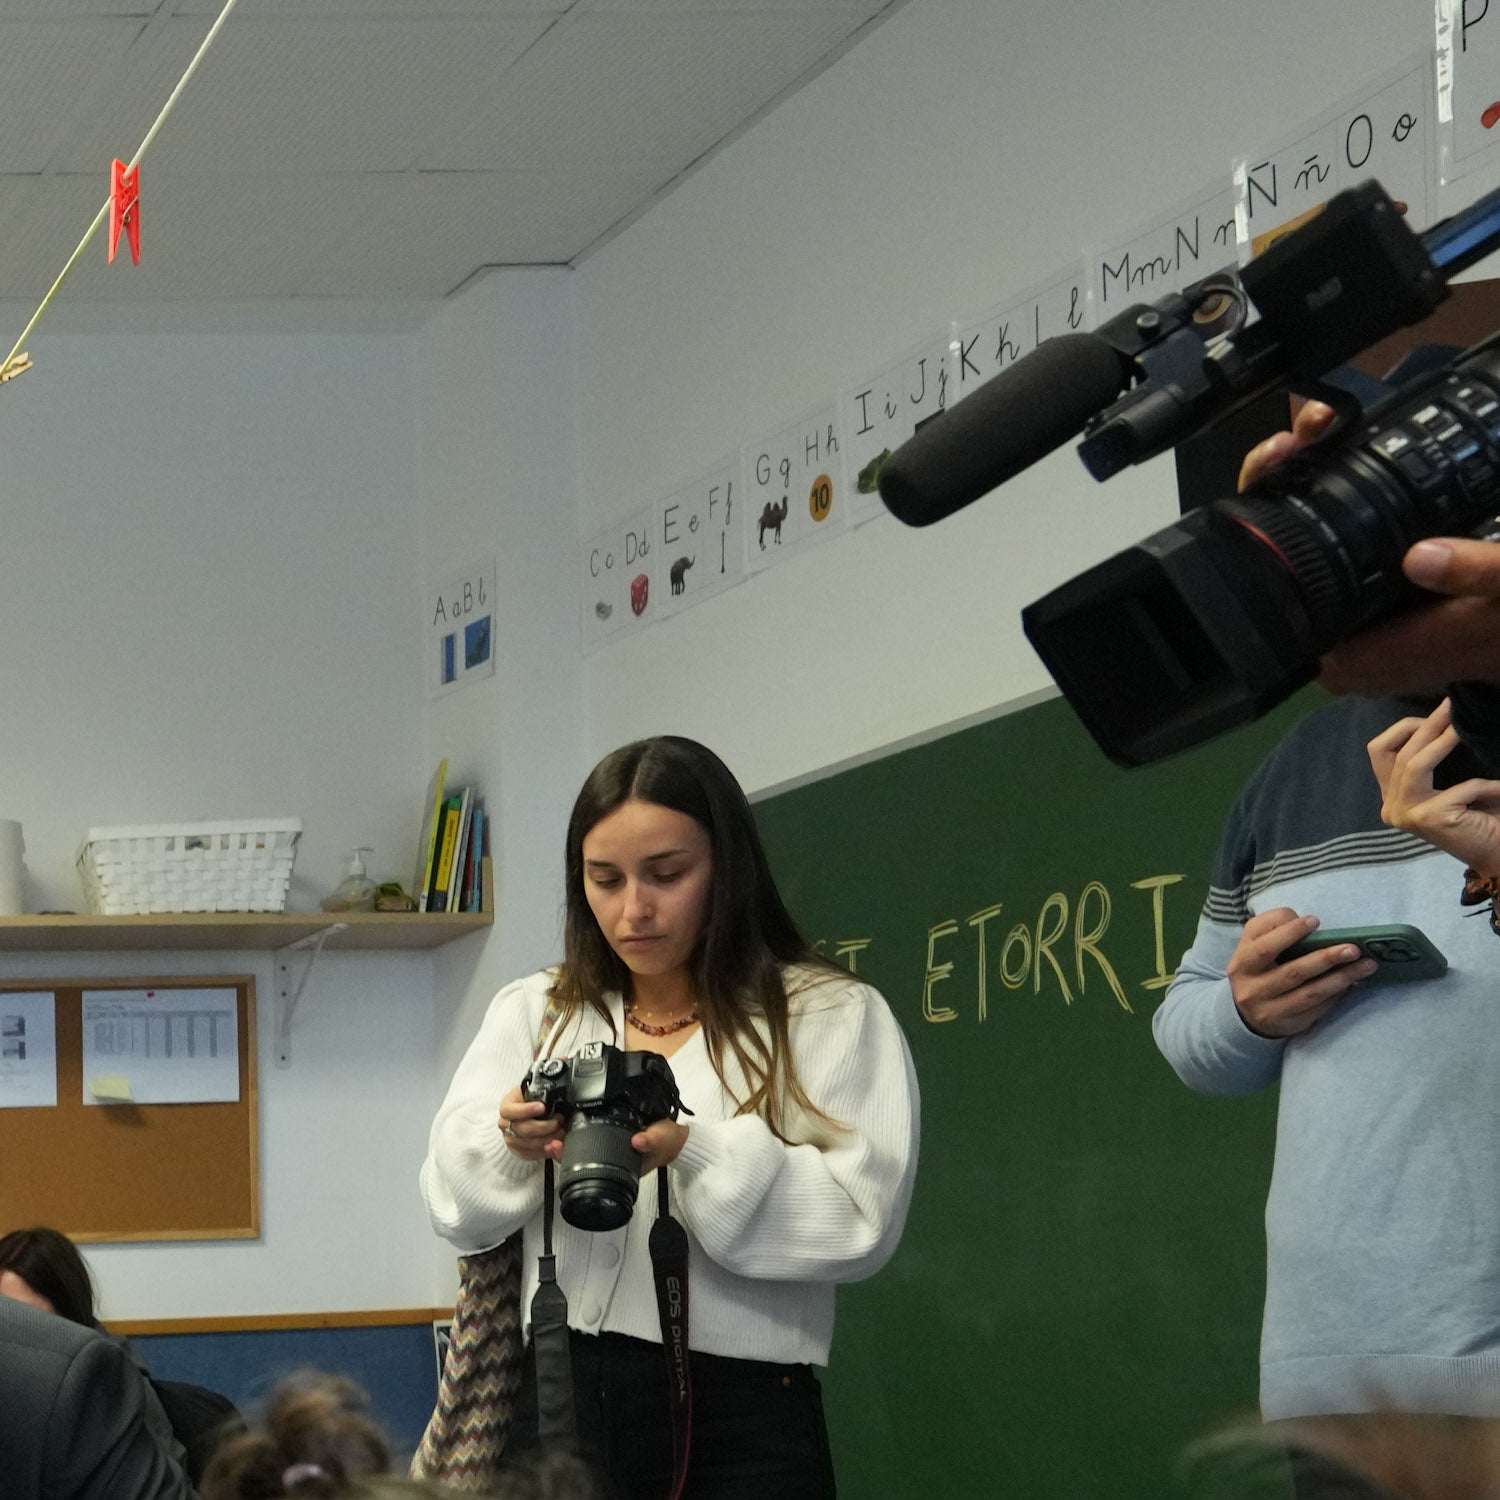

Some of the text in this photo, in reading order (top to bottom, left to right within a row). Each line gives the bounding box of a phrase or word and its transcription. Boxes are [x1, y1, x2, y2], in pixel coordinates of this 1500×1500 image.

[811, 483, 830, 513] 10
[921, 873, 1187, 1024] ETORRI
[666, 1275, 688, 1403] EOS DIGITAL
